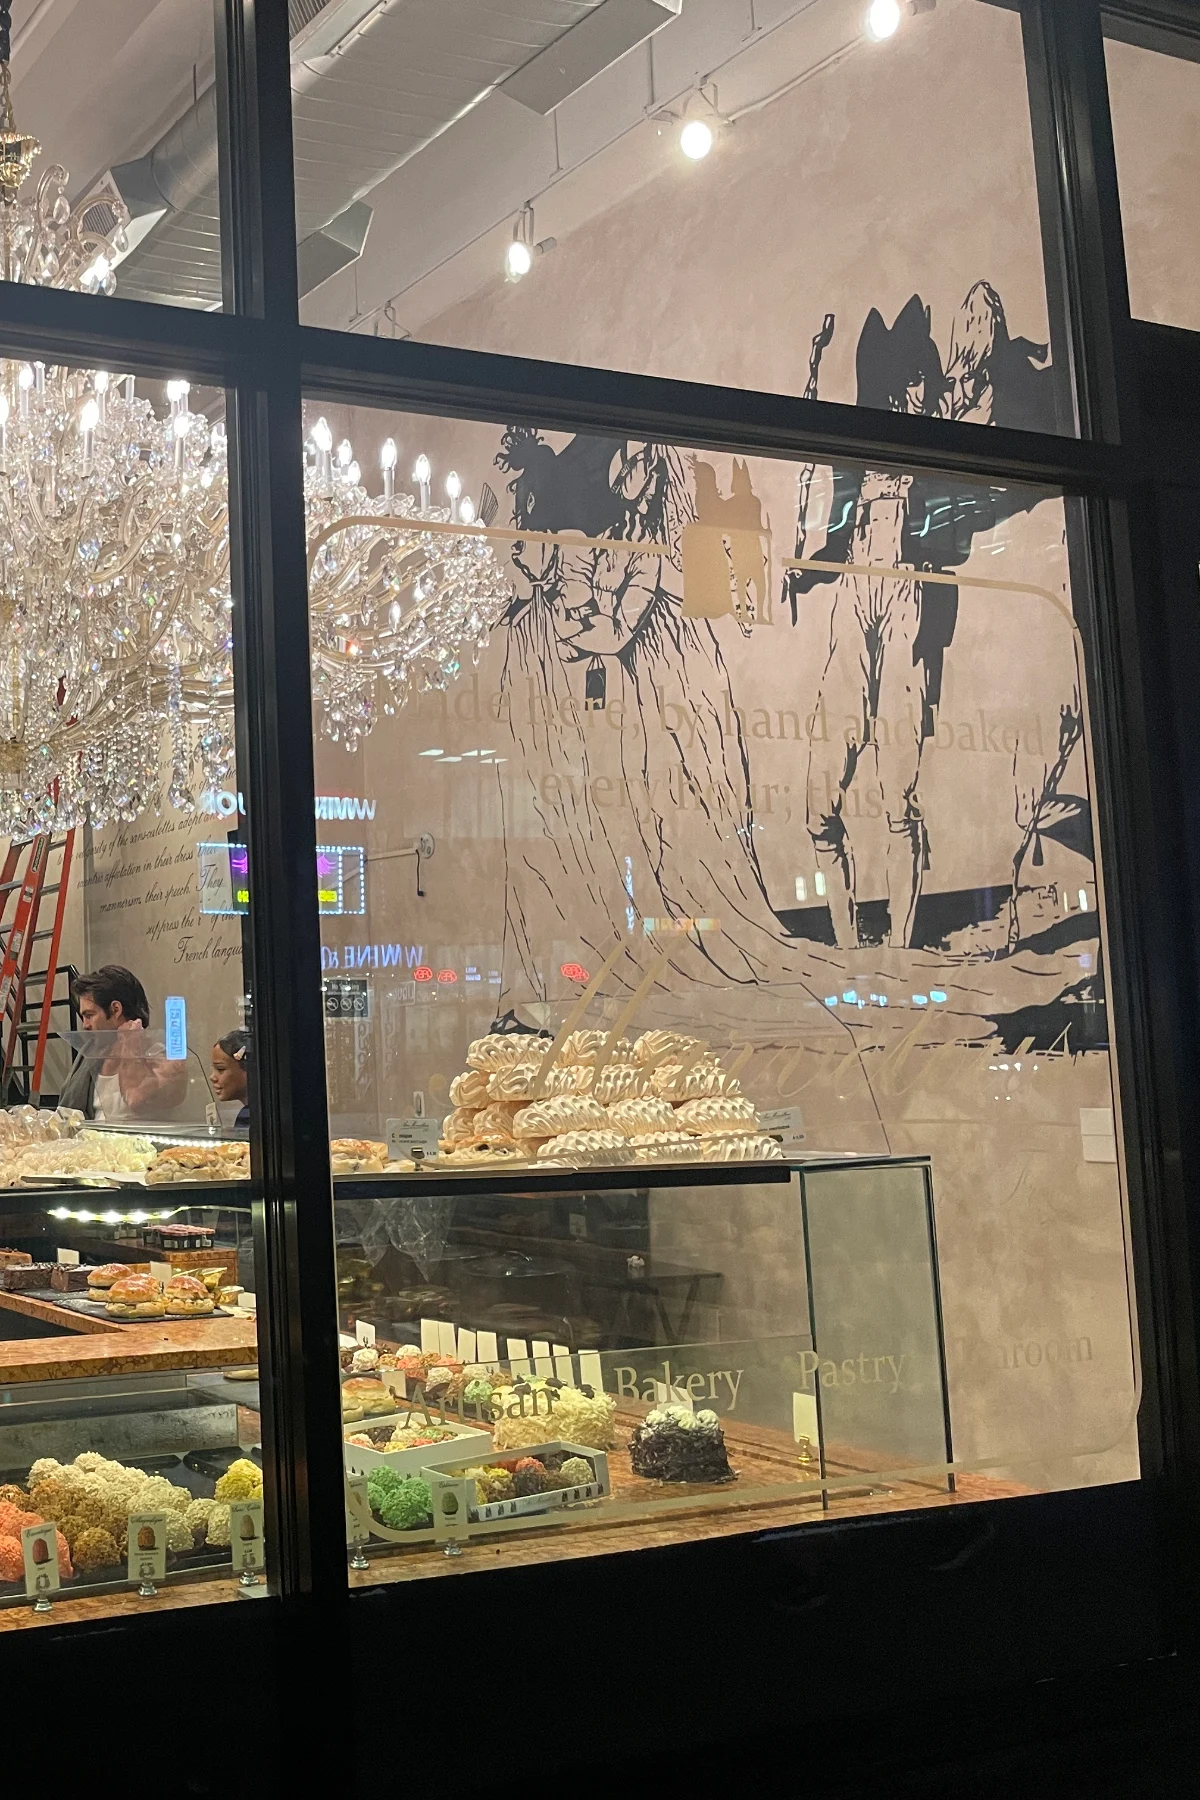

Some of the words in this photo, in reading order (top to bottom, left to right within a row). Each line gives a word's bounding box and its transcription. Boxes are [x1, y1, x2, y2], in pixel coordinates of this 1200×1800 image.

[527, 677, 640, 738] here,
[659, 684, 703, 748] by
[720, 690, 830, 743] hand
[844, 699, 923, 749] and
[934, 704, 1045, 756] baked
[539, 772, 661, 822] every
[674, 761, 793, 824] hour;
[803, 770, 883, 820] this
[143, 860, 152, 872] in
[154, 846, 173, 869] their
[145, 882, 163, 903] their
[196, 864, 223, 896] They
[181, 907, 195, 928] the
[174, 935, 213, 963] French
[401, 1381, 558, 1429] Artisan
[613, 1360, 745, 1411] Bakery
[797, 1349, 907, 1395] Pastry
